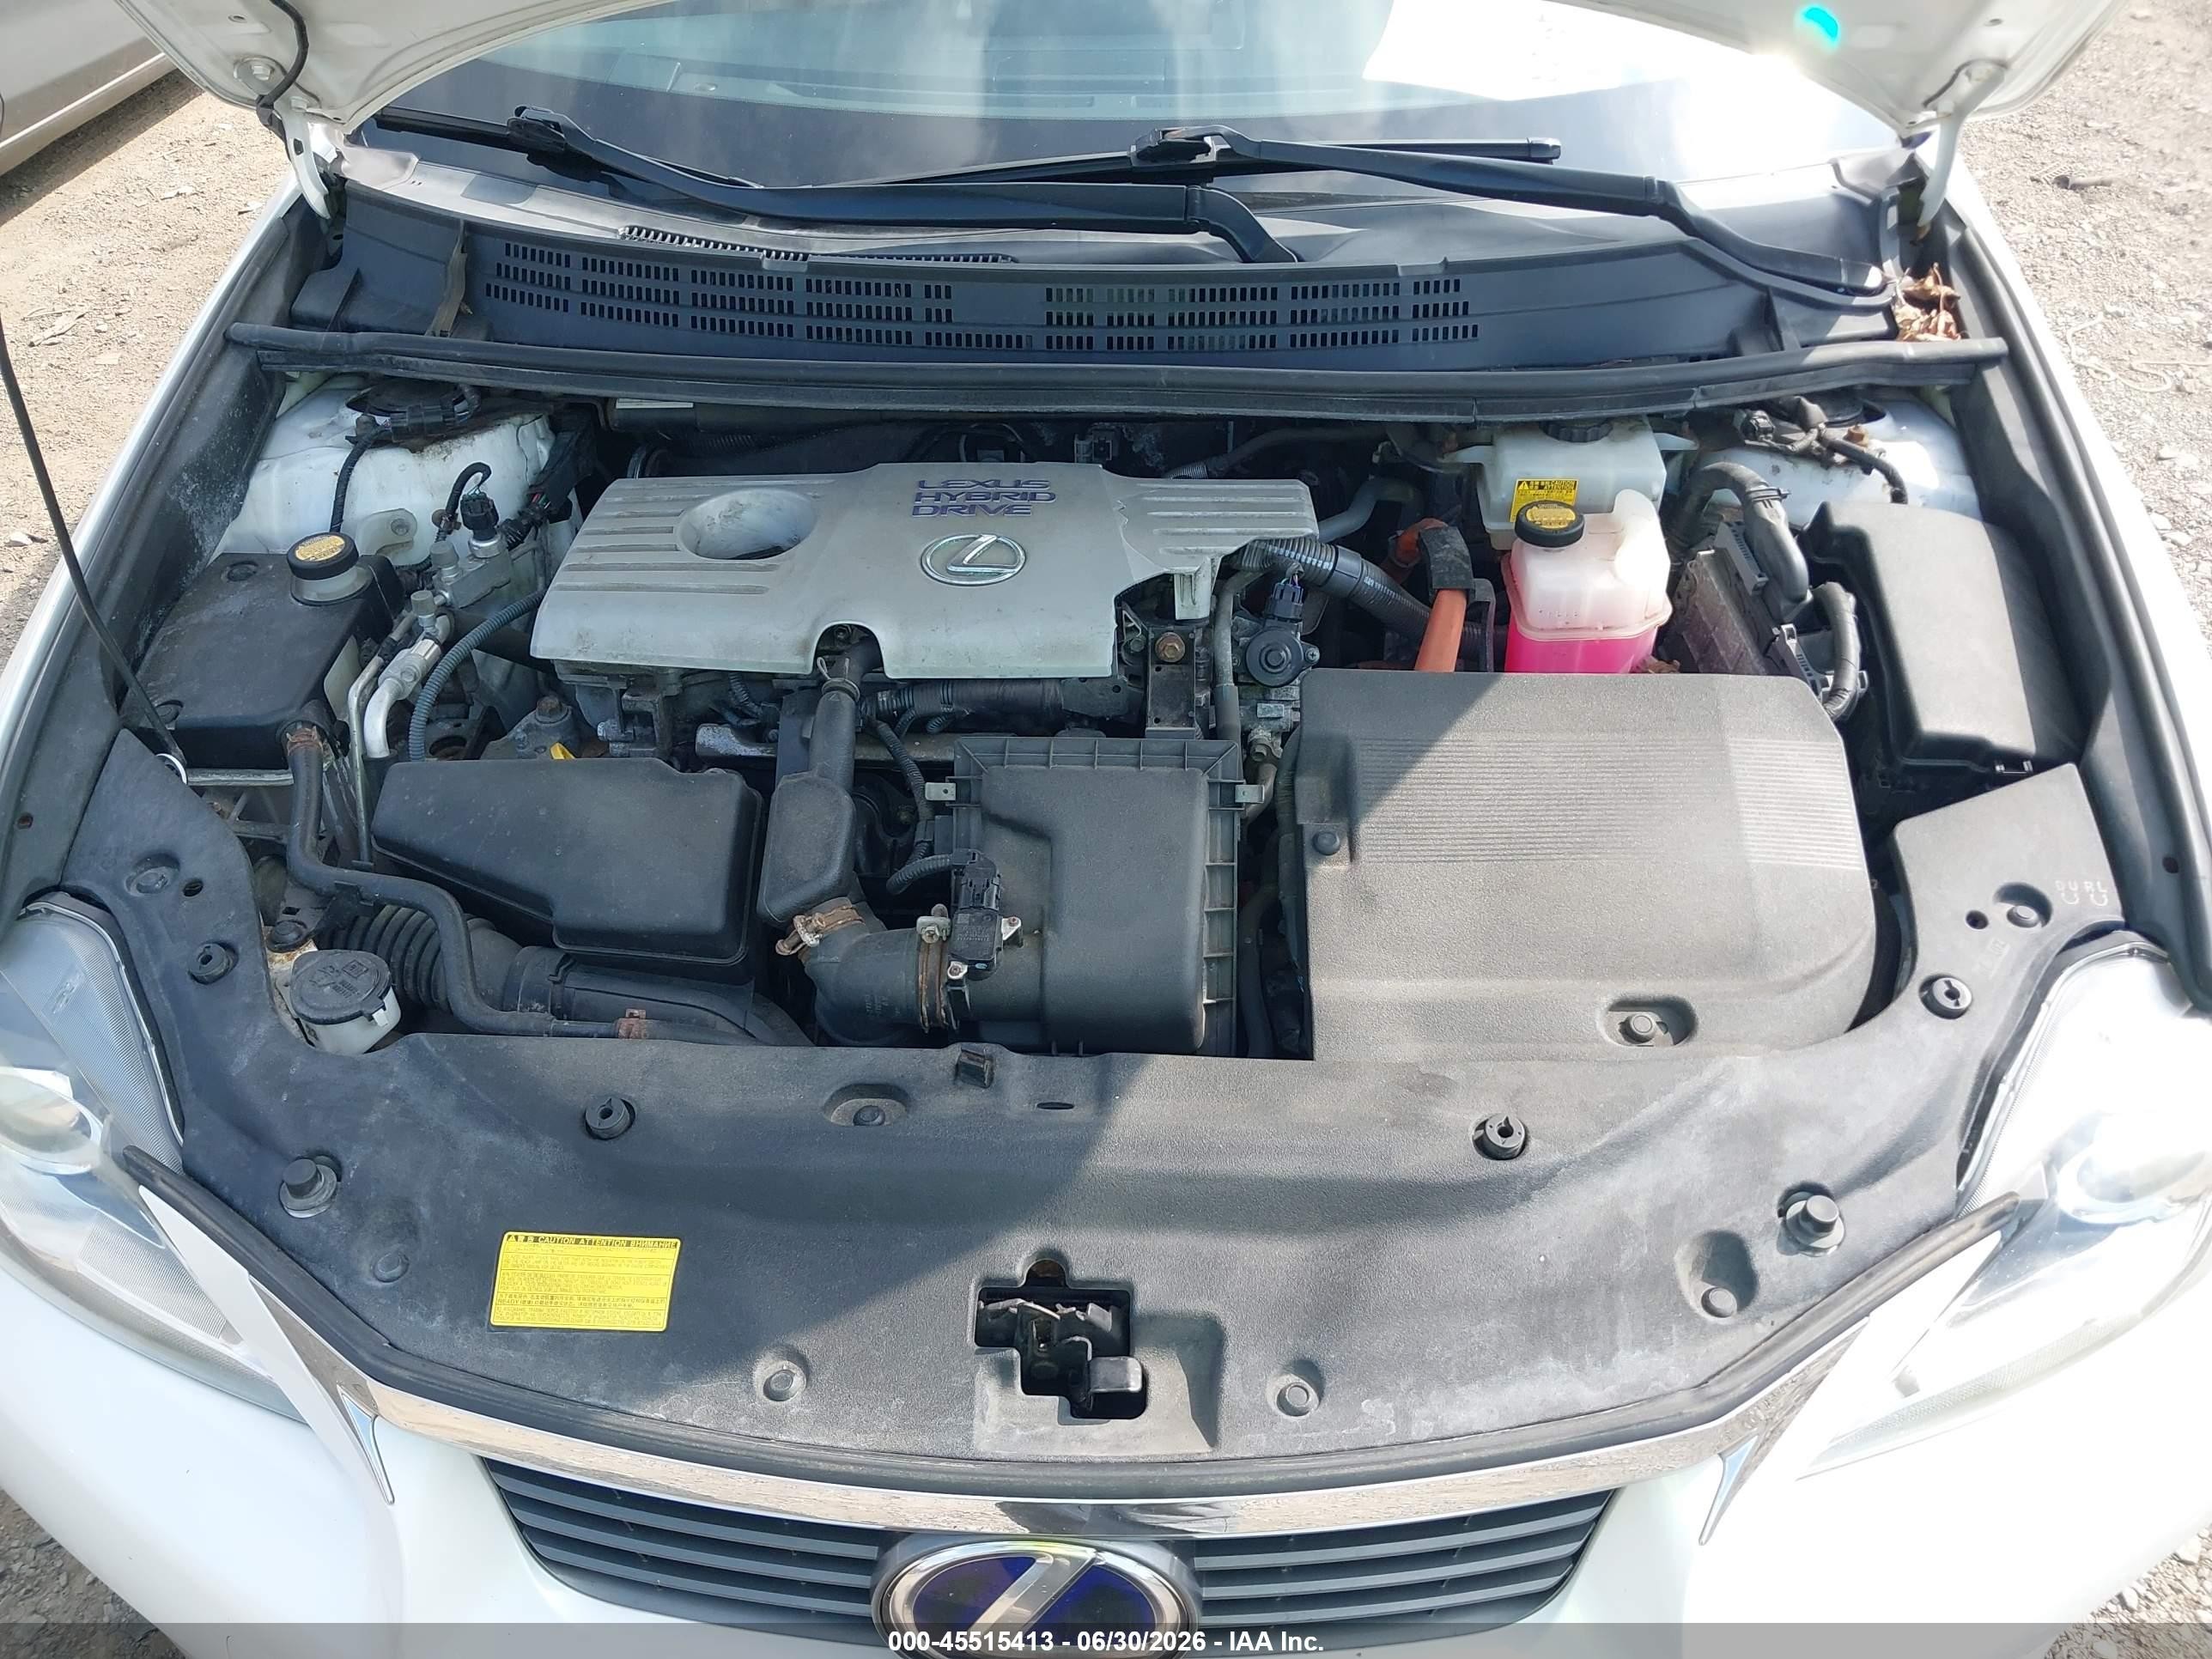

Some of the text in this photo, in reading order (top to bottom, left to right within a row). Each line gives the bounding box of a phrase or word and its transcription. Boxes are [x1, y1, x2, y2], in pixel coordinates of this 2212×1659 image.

[918, 479, 1050, 490] LEXUS
[914, 491, 1056, 503] HYBRID
[912, 503, 1033, 517] DRIVE
[538, 1236, 576, 1244] CAUTION
[579, 1237, 627, 1247] ATTENTION
[630, 1239, 678, 1249] ВНИМАНИЕ
